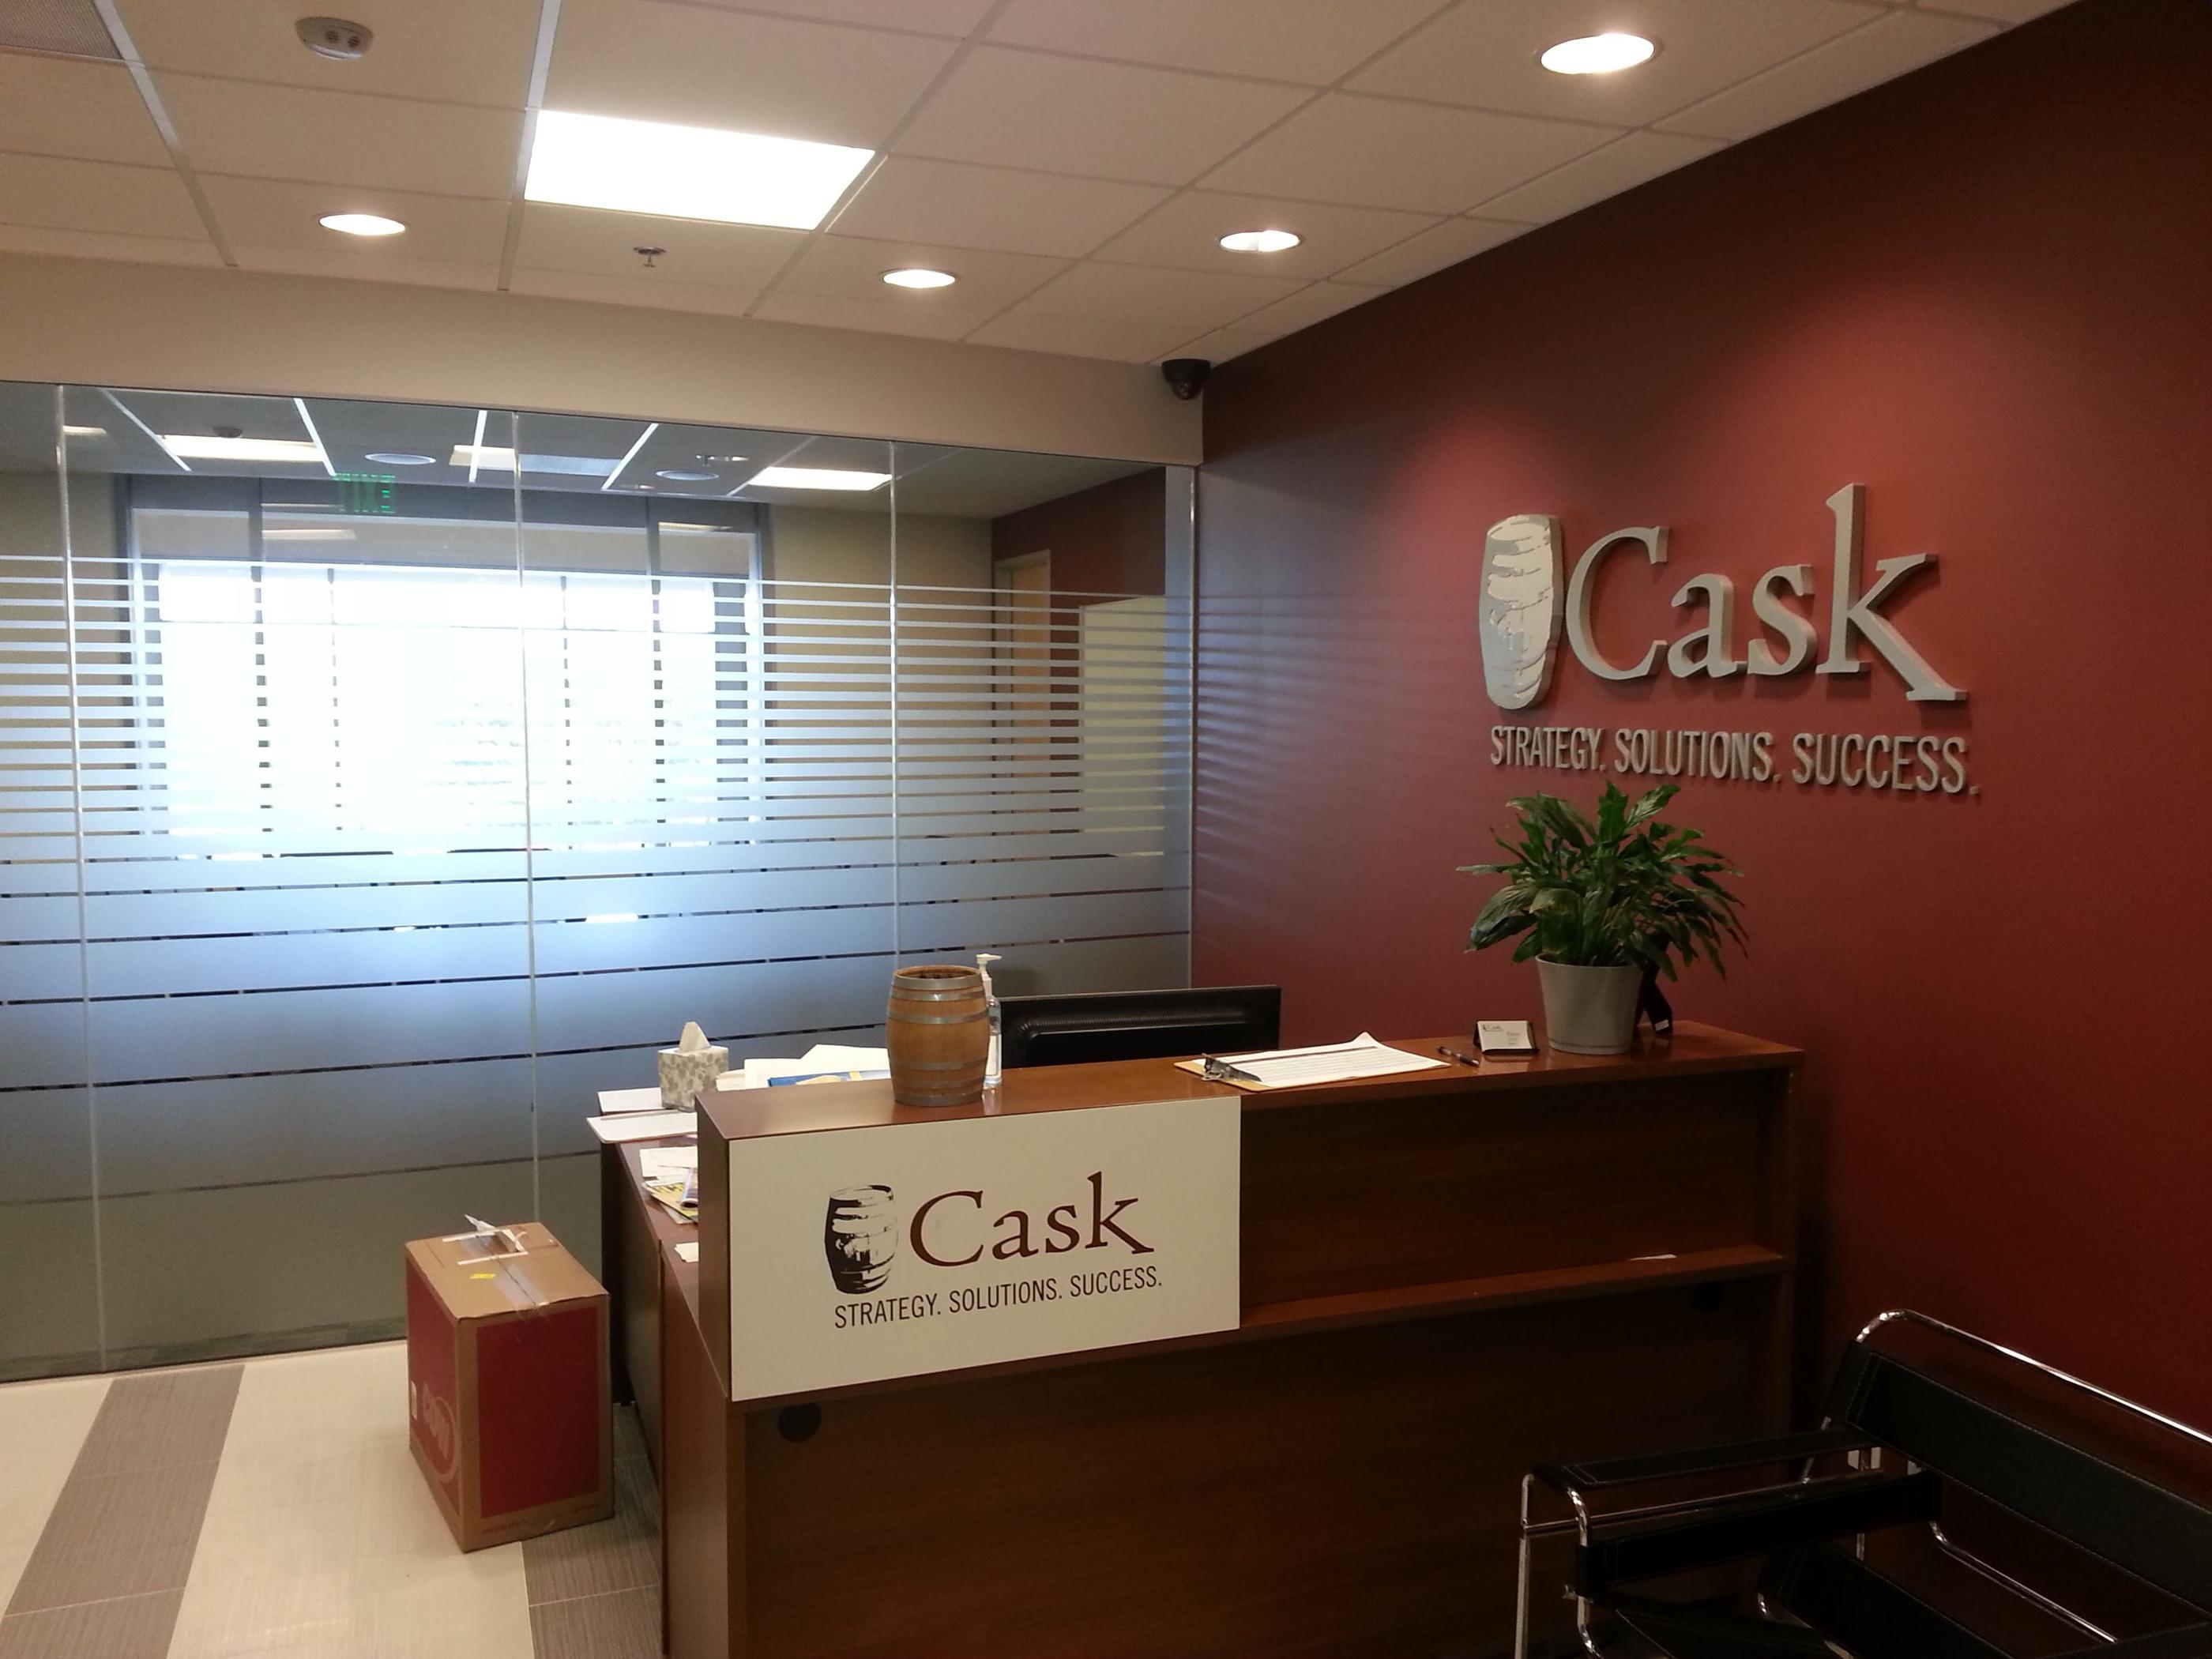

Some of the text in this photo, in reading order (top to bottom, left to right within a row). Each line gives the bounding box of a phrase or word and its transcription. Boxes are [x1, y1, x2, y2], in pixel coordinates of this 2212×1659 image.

[1565, 482, 1968, 702] Cask
[1490, 725, 1981, 795] STRATEGY. SOLUTIONS. SUCCESS.
[909, 1171, 1155, 1268] Cask
[834, 1266, 1163, 1329] STRATEGY. SOLUTIONS. SUCCESS.
